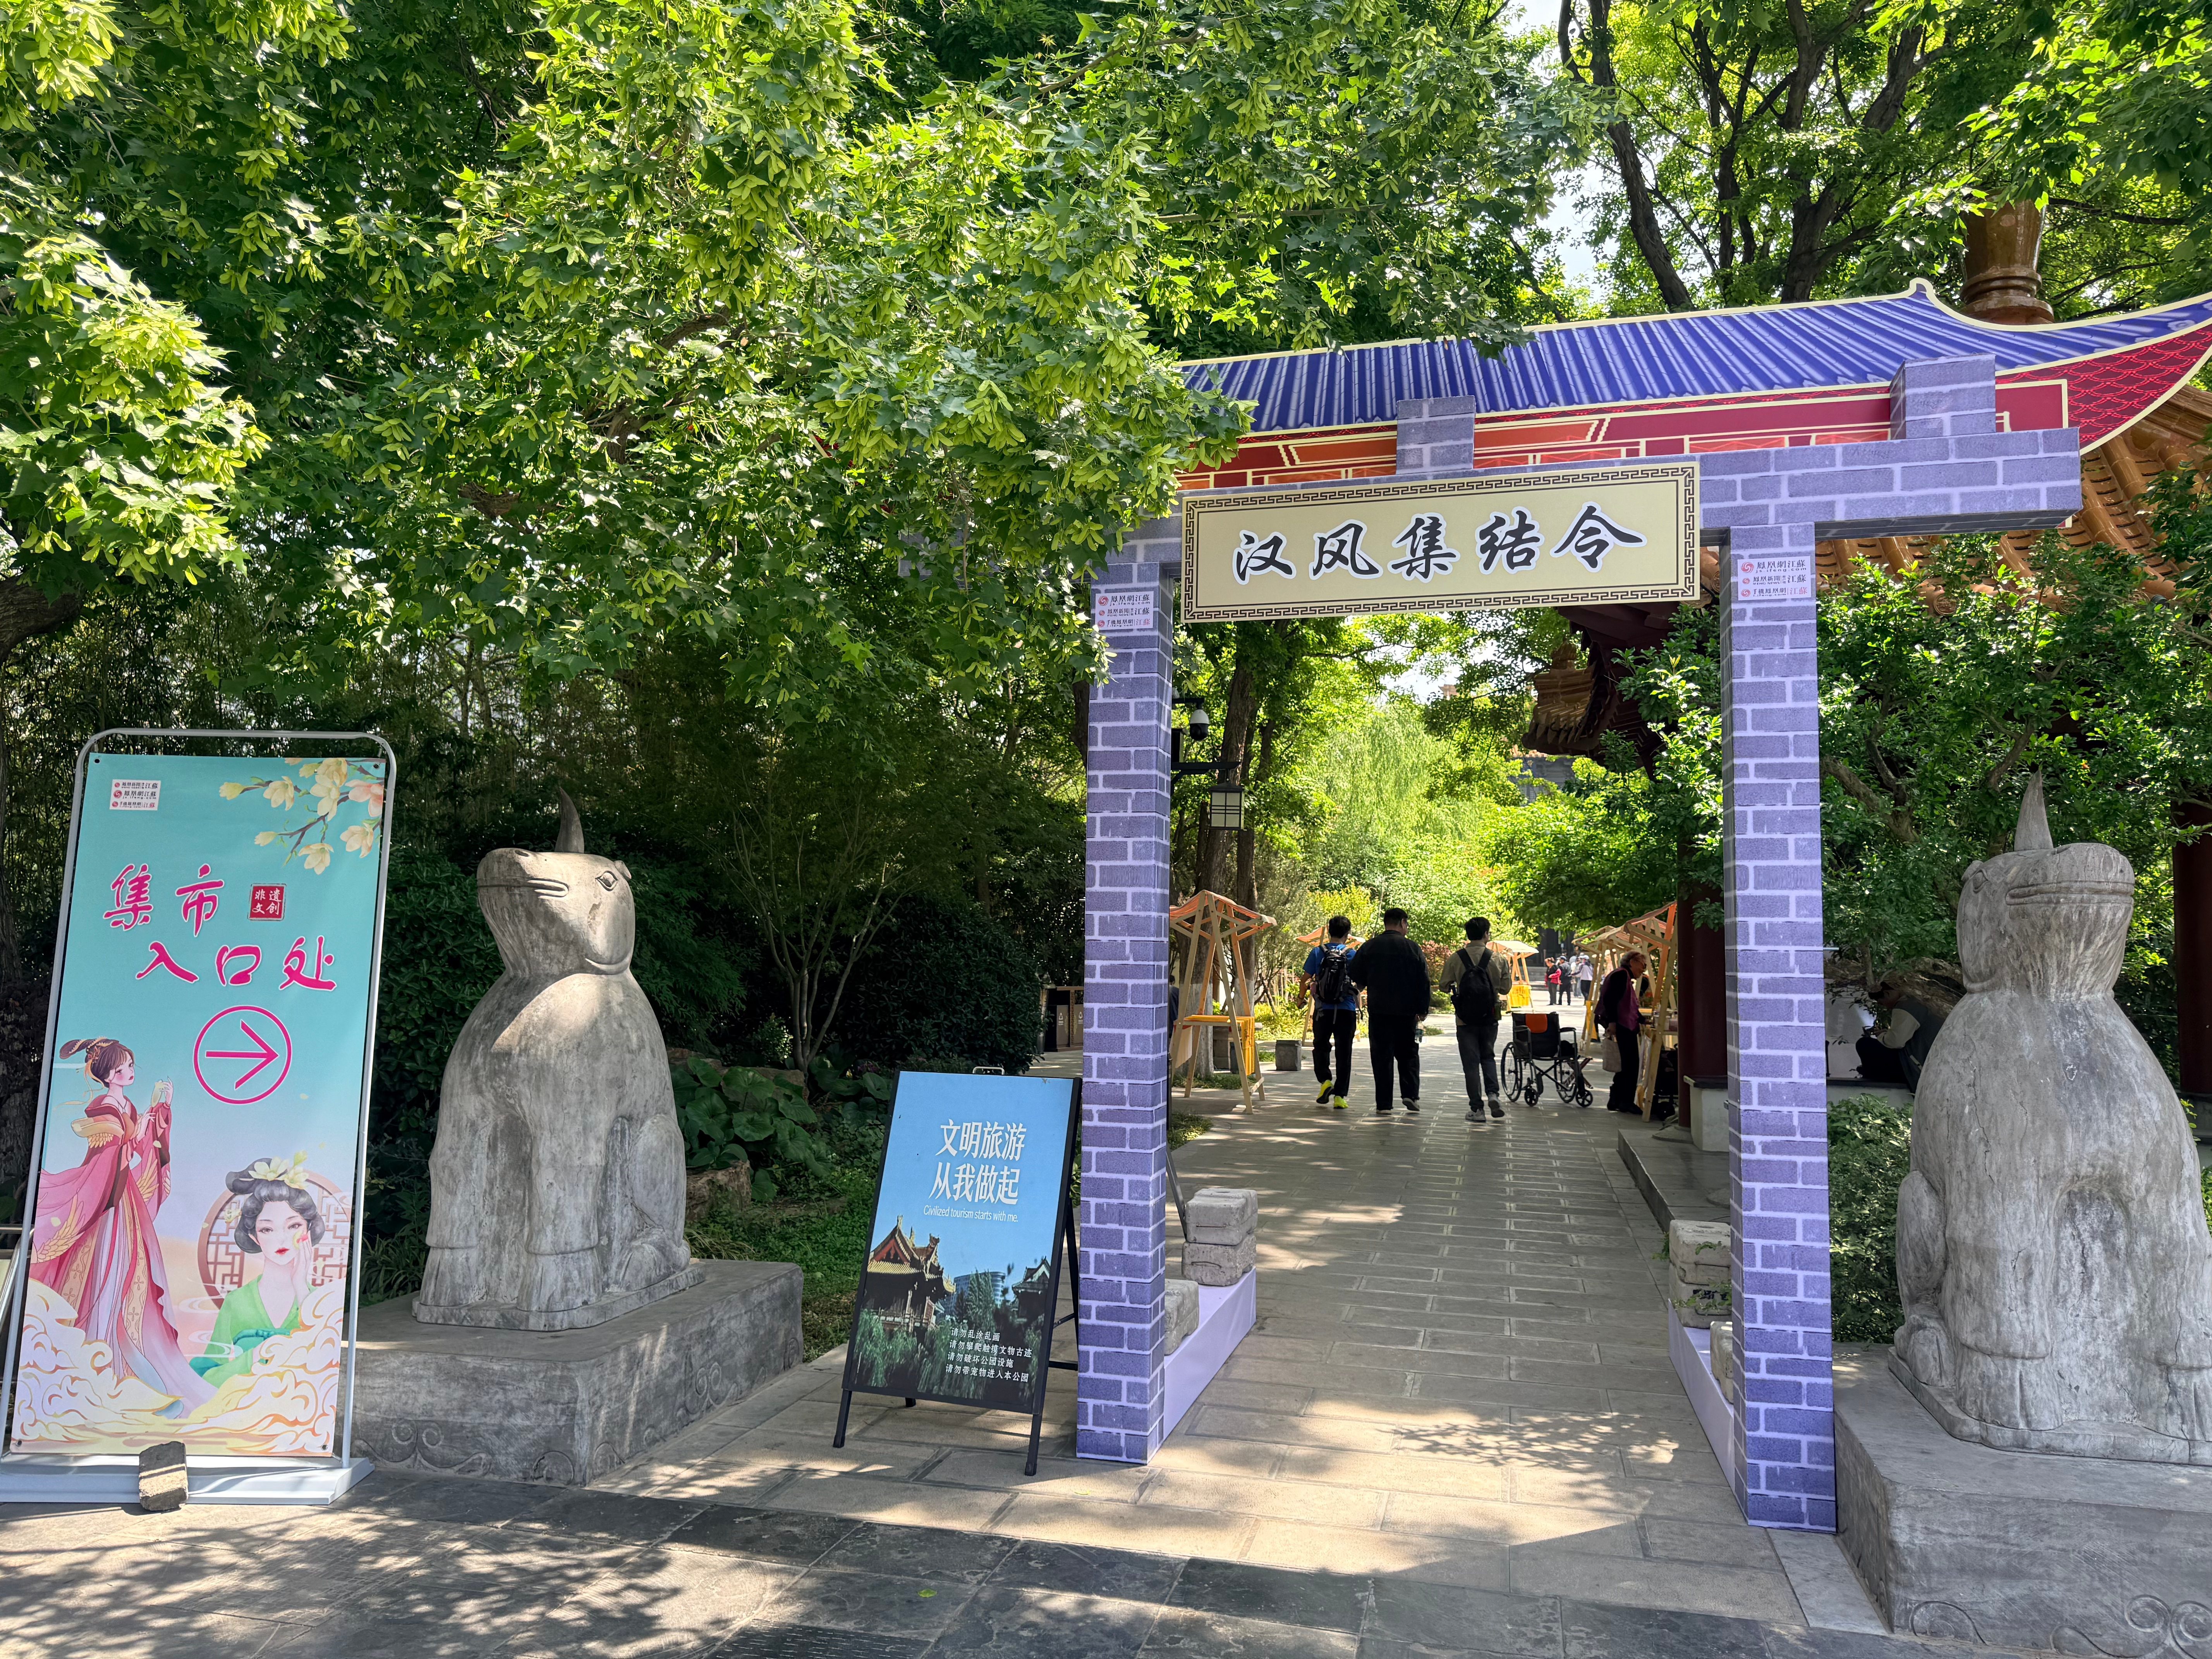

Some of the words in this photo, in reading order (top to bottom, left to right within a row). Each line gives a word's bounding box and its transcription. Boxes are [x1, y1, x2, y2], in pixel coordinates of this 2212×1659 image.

[1238, 505, 1644, 580] 汉风集结令
[104, 864, 224, 936] 集市
[136, 936, 337, 991] 入口处
[935, 1119, 1027, 1161] 文明旅游
[928, 1162, 1020, 1205] 从我做起
[924, 1205, 950, 1216] Civilized
[951, 1208, 974, 1219] tourism
[974, 1211, 992, 1220] starts
[993, 1211, 1006, 1221] with
[1007, 1214, 1018, 1222] me.
[950, 1340, 1032, 1358] 请勿攀爬触摸文物古迹
[951, 1328, 1001, 1342] 请勿乱涂乱画
[946, 1364, 1029, 1382] 请勿带宠物进入本公园
[948, 1352, 1014, 1368] 请勿破坏公园设施
